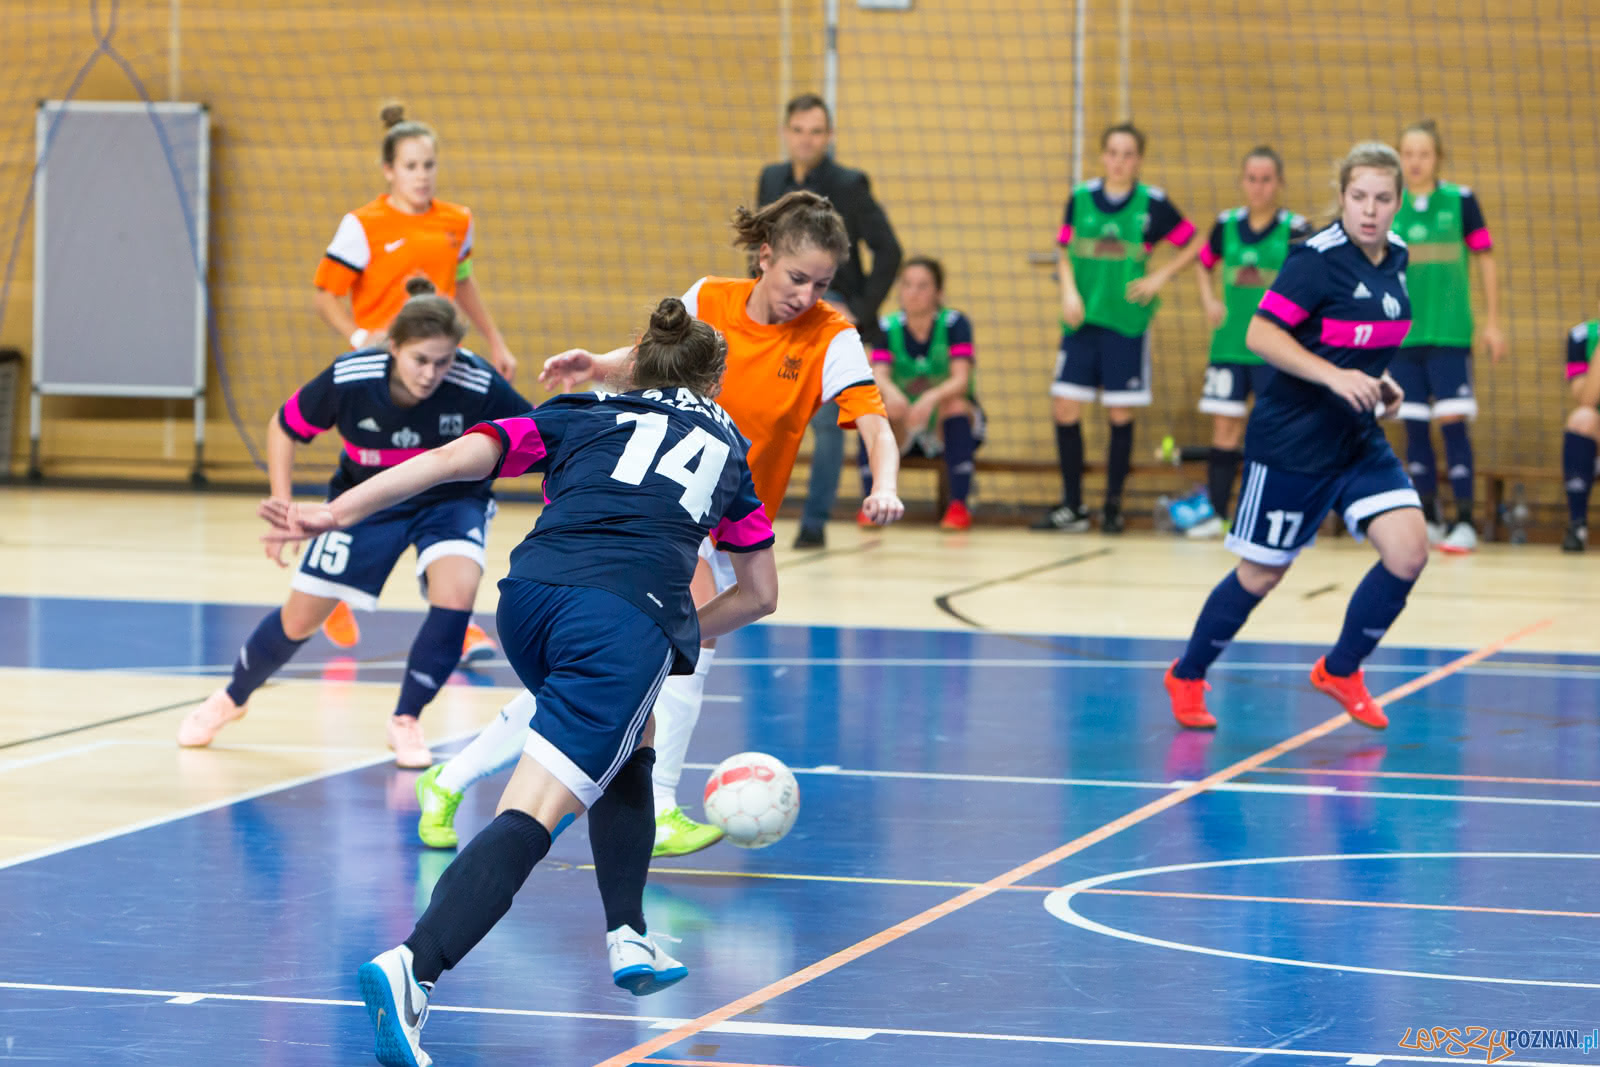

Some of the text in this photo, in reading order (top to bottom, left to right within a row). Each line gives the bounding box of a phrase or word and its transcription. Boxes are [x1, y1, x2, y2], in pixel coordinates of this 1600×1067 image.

[1353, 324, 1373, 346] 17
[610, 412, 730, 523] 14
[1266, 510, 1303, 548] 17
[308, 531, 353, 576] 15
